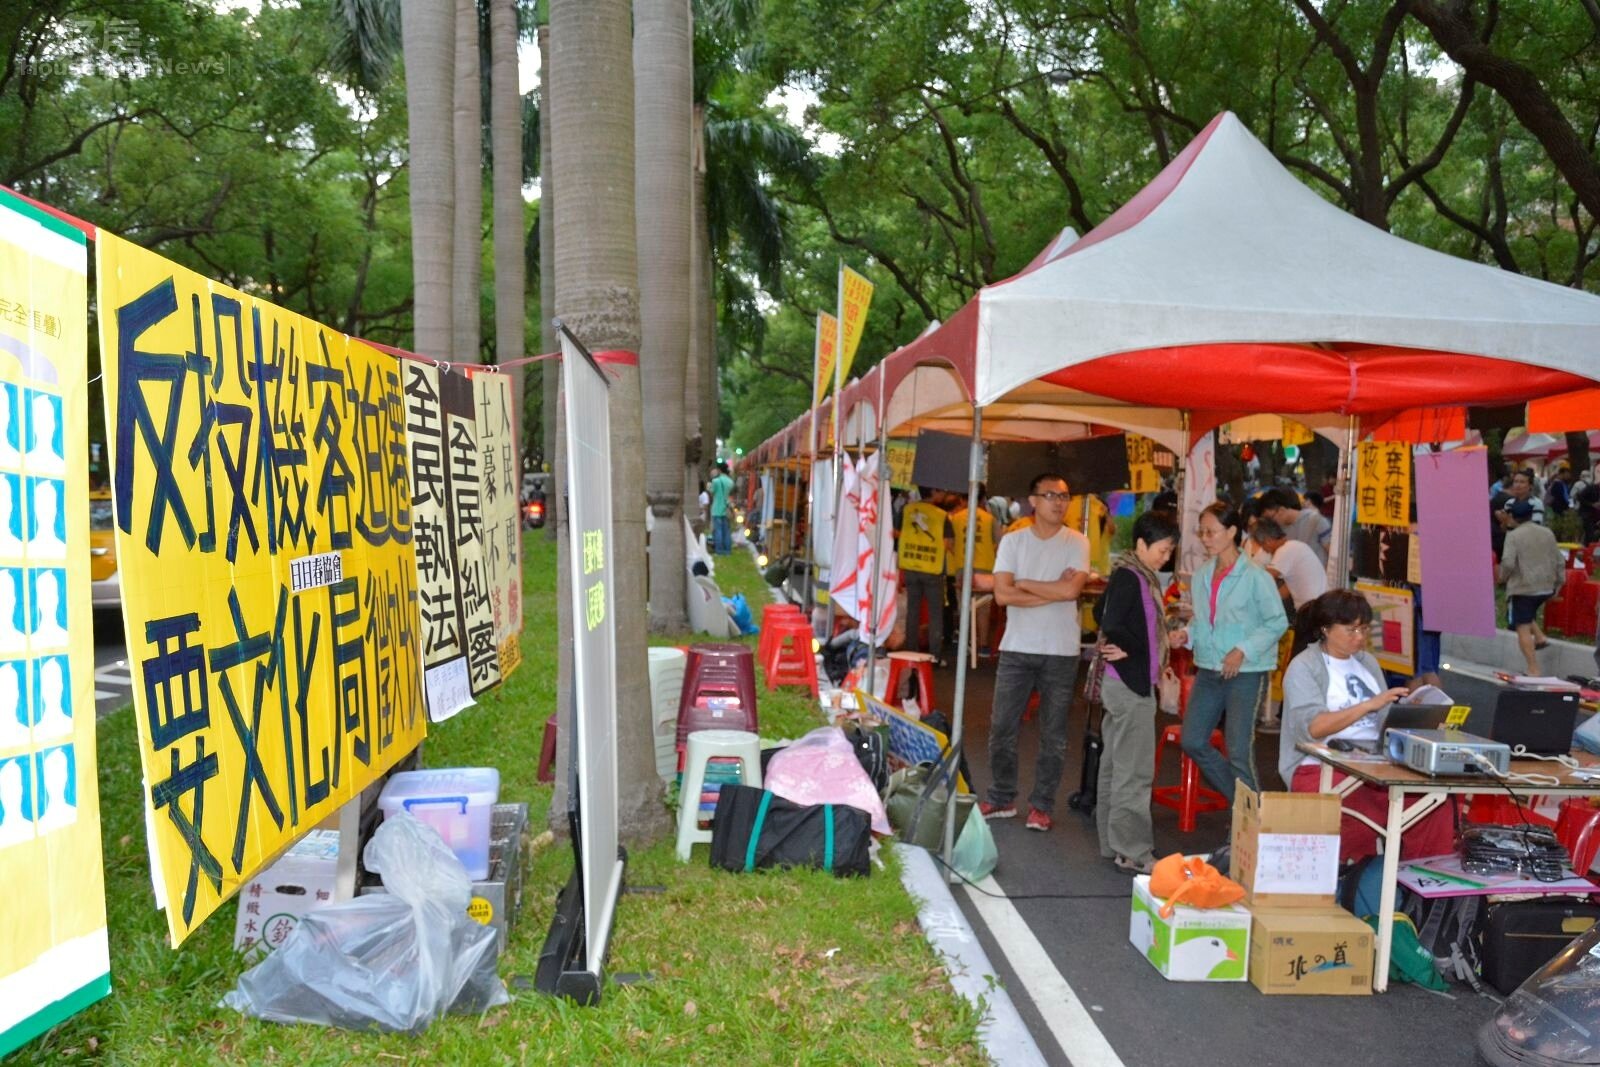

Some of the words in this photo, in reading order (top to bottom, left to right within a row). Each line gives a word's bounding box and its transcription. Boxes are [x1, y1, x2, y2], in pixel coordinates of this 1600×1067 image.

[115, 275, 413, 566] 反投機客迫遷
[405, 366, 459, 656] 全民執法
[450, 421, 500, 685] 全民糾察
[290, 554, 341, 591] 日日春協會
